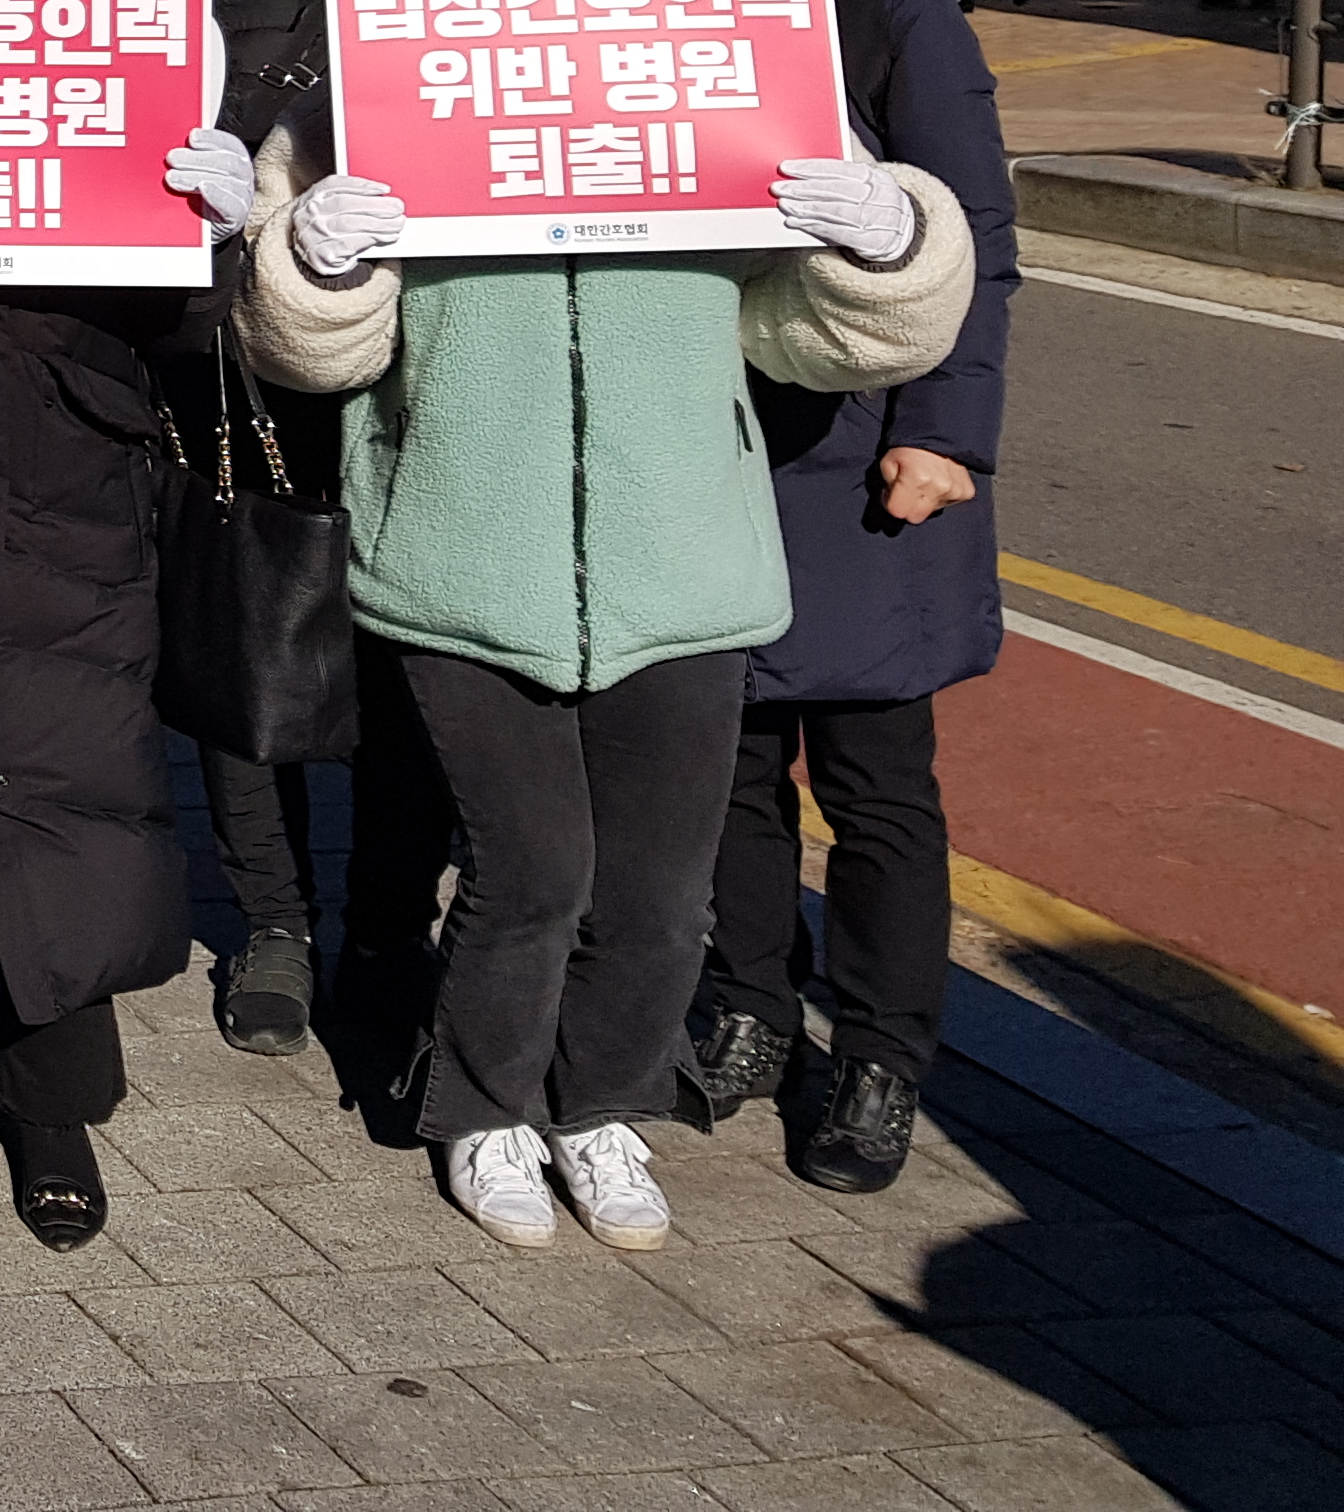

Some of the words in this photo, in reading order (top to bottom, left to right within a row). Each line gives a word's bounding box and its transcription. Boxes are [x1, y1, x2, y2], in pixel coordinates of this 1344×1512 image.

[418, 45, 577, 119] 위반
[599, 39, 759, 112] 병원
[487, 120, 699, 200] 퇴출!!
[574, 223, 649, 236] 대한간호협회
